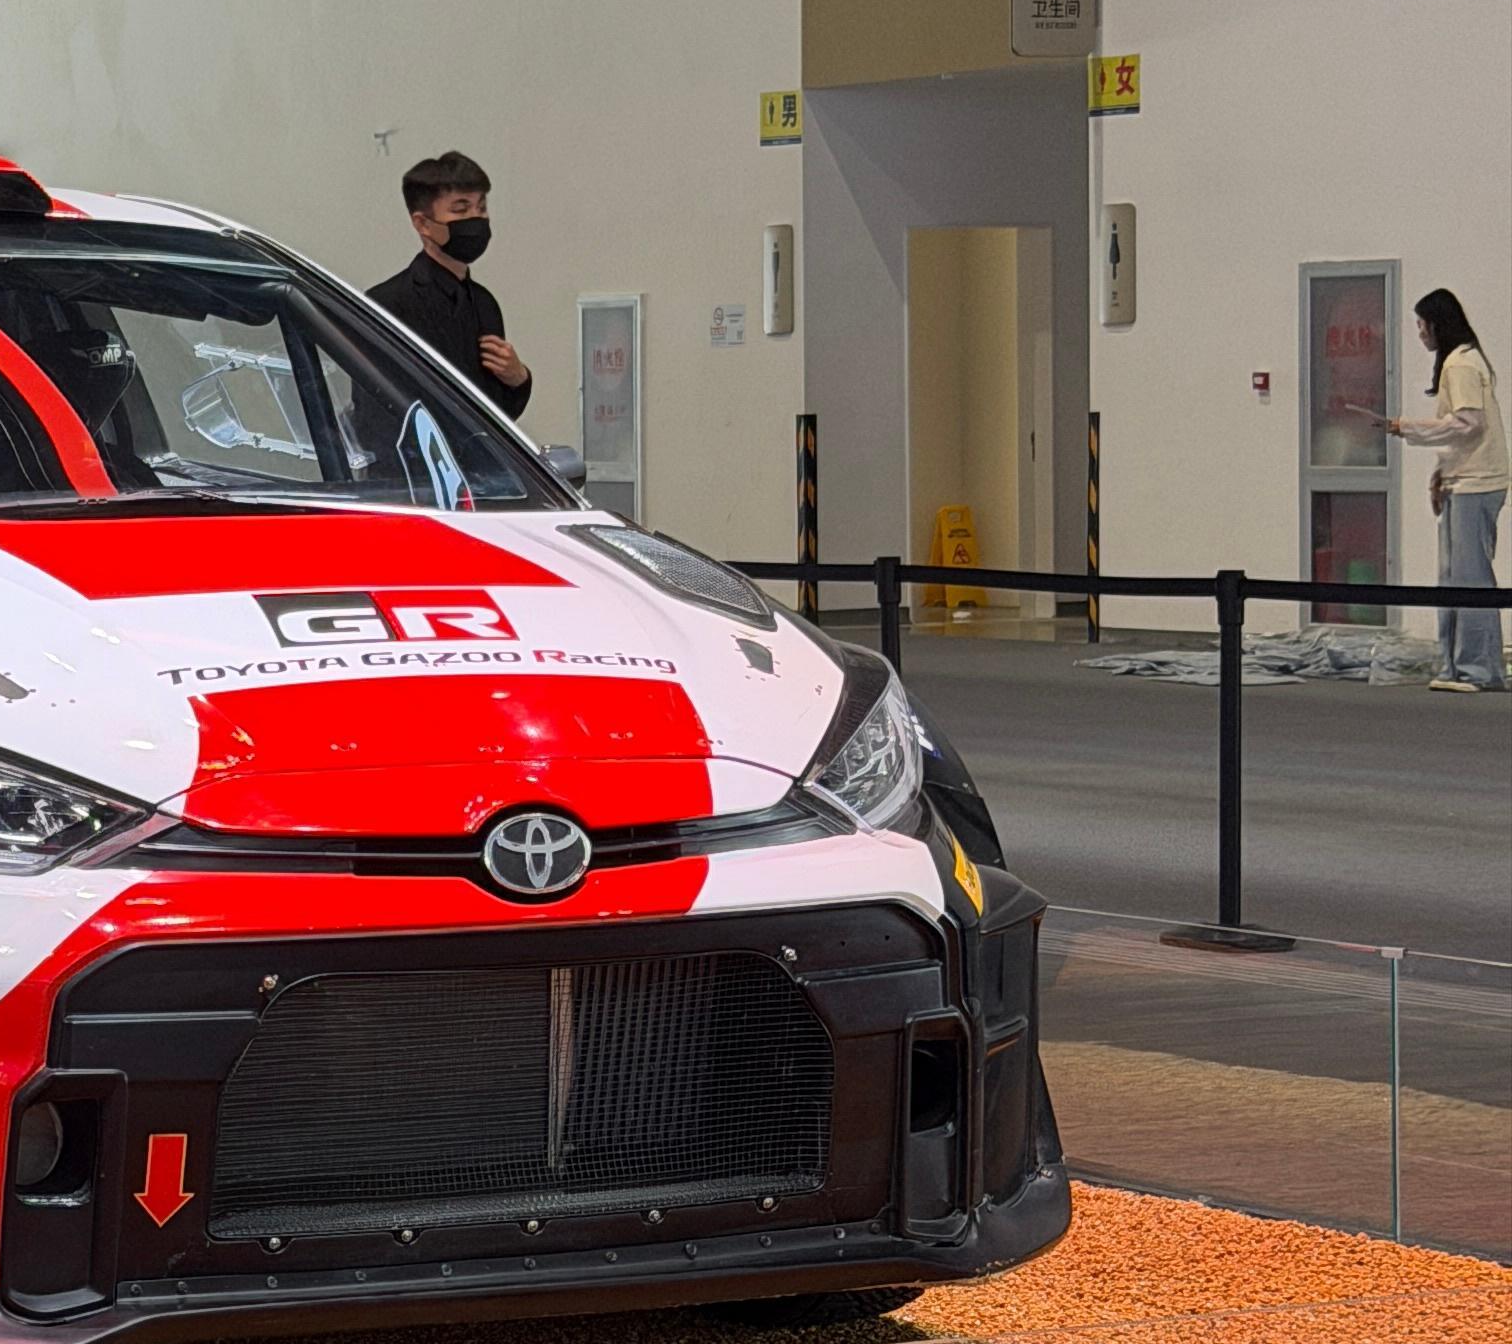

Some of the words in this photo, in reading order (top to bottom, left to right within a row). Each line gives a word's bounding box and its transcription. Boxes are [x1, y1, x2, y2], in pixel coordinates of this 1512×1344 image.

[1032, 0, 1080, 18] 卫生间
[1115, 57, 1135, 96] 女
[782, 94, 797, 128] 男
[277, 606, 511, 643] GR
[157, 655, 344, 686] TOYOTA
[361, 650, 522, 667] GAZOO
[534, 650, 677, 674] Racing
